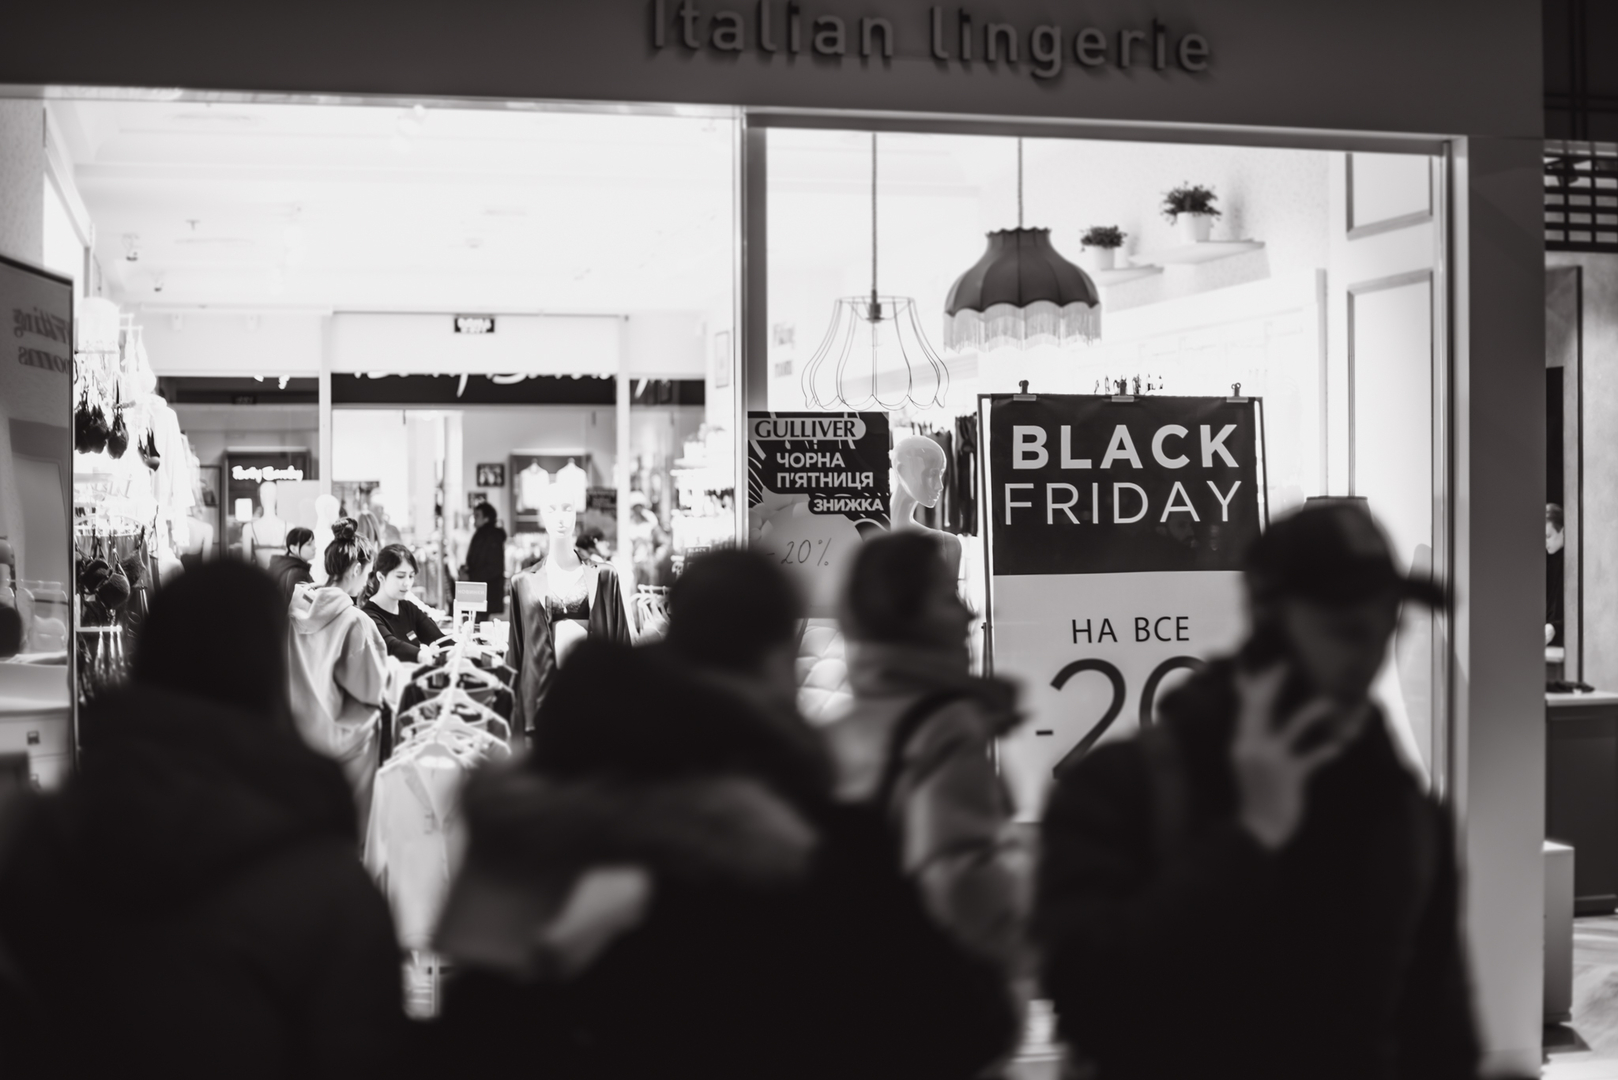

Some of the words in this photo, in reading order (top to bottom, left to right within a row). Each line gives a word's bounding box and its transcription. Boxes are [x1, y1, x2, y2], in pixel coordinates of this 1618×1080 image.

[653, 0, 893, 56] Italian
[932, 6, 1210, 79] lingerie
[754, 420, 857, 438] GULLIVER
[1012, 424, 1240, 470] BLACK
[776, 452, 846, 468] ЧОРНА
[776, 471, 874, 490] П'ЯТНИЦЯ
[813, 498, 885, 512] ЗНИЖКА
[1004, 480, 1242, 526] FRIDAY
[1071, 618, 1118, 644] НА
[1134, 616, 1190, 642] ВСЕ
